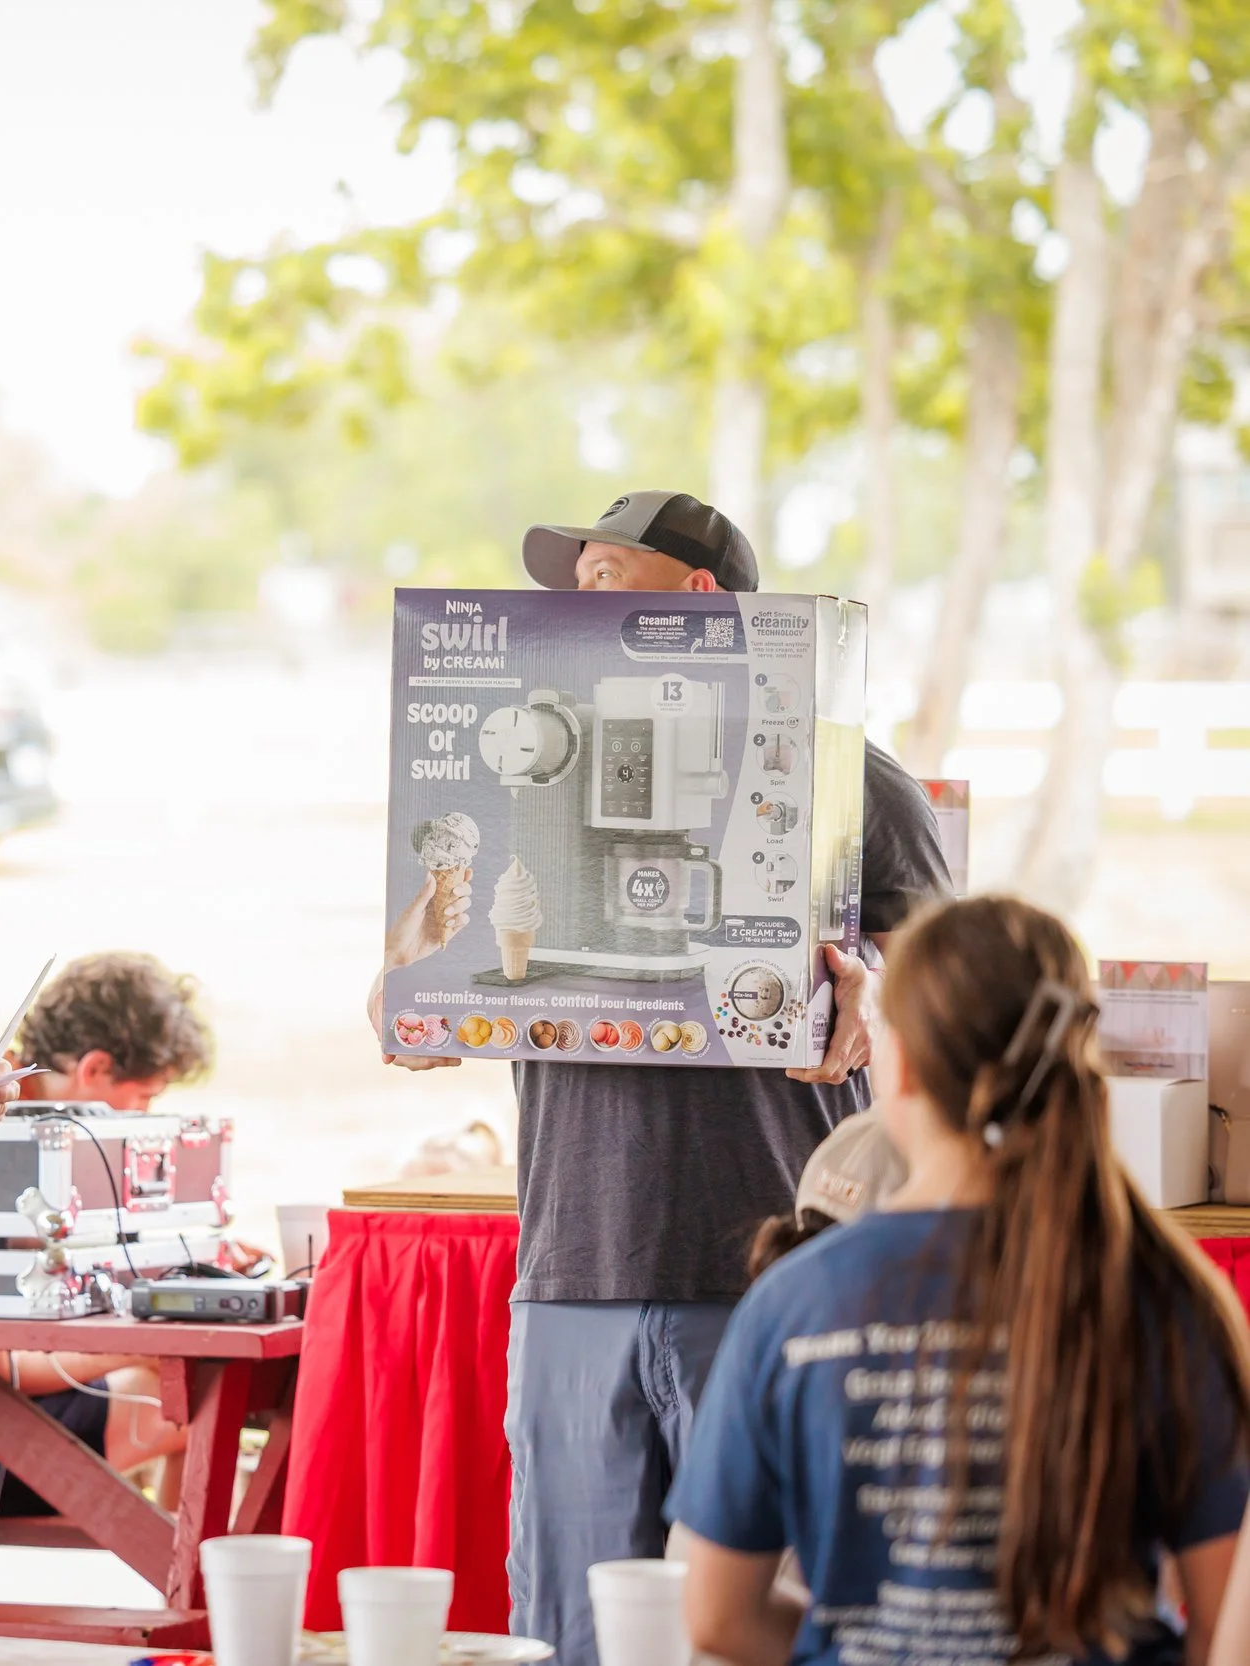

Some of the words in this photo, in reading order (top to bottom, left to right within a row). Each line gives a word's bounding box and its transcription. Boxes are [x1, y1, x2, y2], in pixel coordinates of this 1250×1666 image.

[446, 600, 482, 616] NINJA
[751, 616, 809, 628] Creamify
[421, 616, 508, 651] swirl
[424, 656, 439, 670] by
[443, 656, 504, 670] CREAMi
[662, 681, 683, 701] 13
[407, 703, 478, 728] scoop
[428, 730, 455, 752] or
[412, 754, 470, 780] swirl
[632, 880, 654, 896] 4x
[732, 929, 737, 937] 2
[777, 930, 798, 938] Swirl
[414, 990, 484, 1004] customize
[484, 996, 508, 1006] your
[510, 994, 548, 1007] flavors,
[551, 994, 599, 1008] control
[601, 999, 624, 1009] your
[626, 998, 686, 1011] ingredients.
